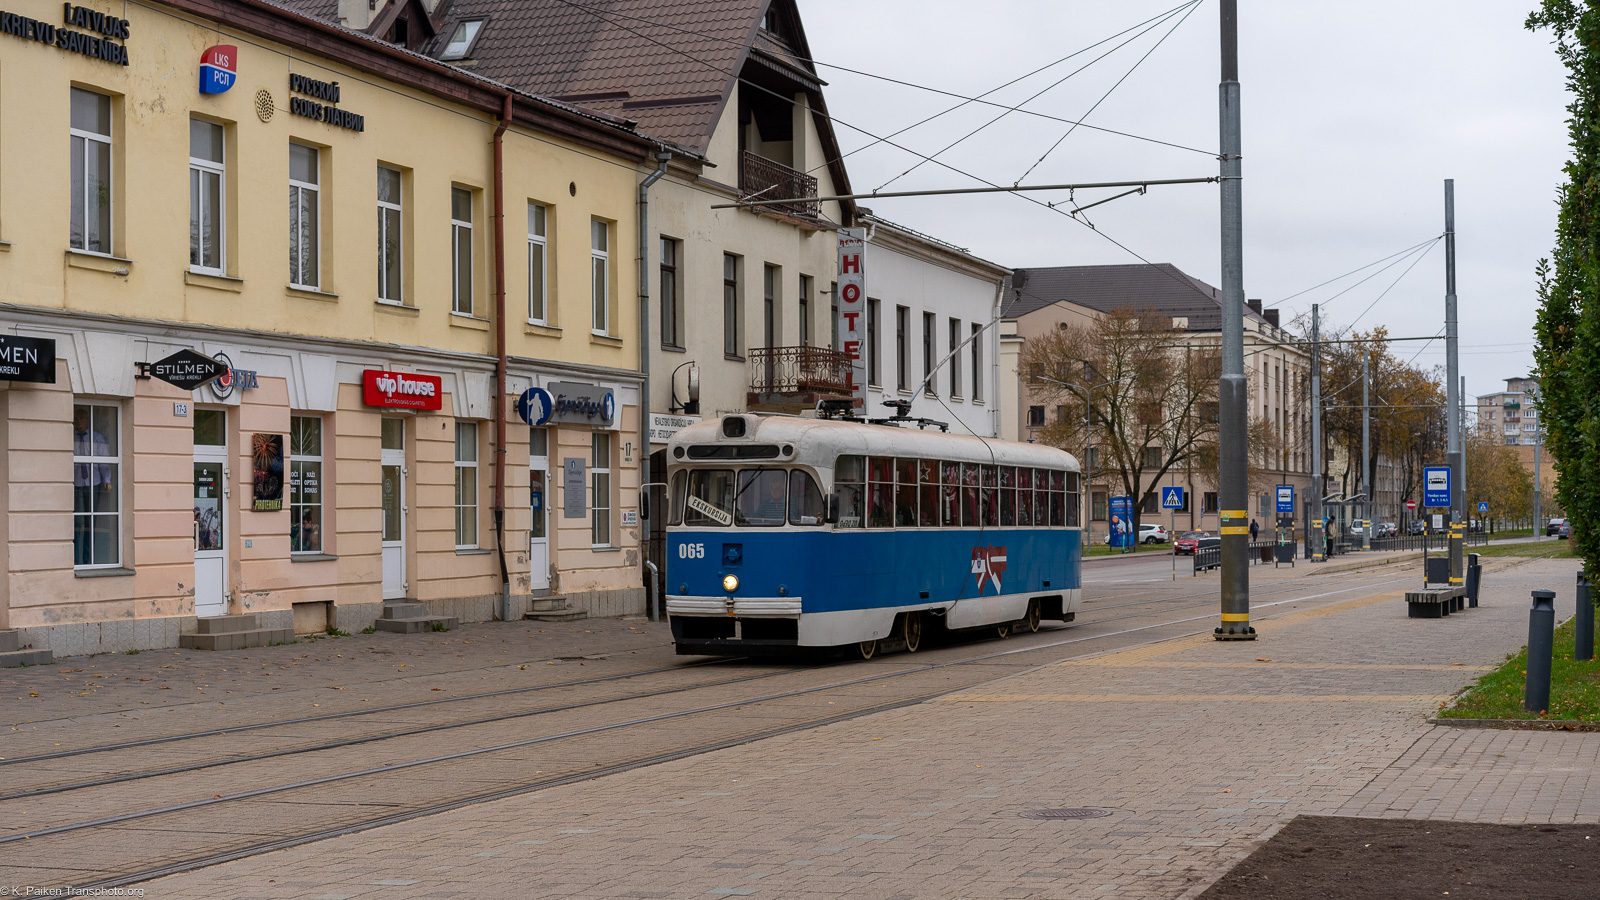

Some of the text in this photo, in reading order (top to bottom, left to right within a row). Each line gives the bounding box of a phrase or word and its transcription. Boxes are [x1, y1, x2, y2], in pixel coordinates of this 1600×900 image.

[64, 2, 130, 40] LATVIJAS
[0, 10, 129, 66] KRIEVU SAVIENĪBA
[214, 52, 229, 68] LKS
[214, 70, 230, 87] РСЛ
[290, 73, 340, 103] РУССКИЙ
[290, 97, 364, 132] СОЮЗ ЛАТВИИ
[156, 364, 215, 375] STILMEN
[376, 373, 436, 398] vip house
[176, 405, 188, 414] 17-3
[625, 442, 632, 456] 17
[692, 499, 728, 523] EKSKURSIJA
[679, 543, 705, 559] 065
